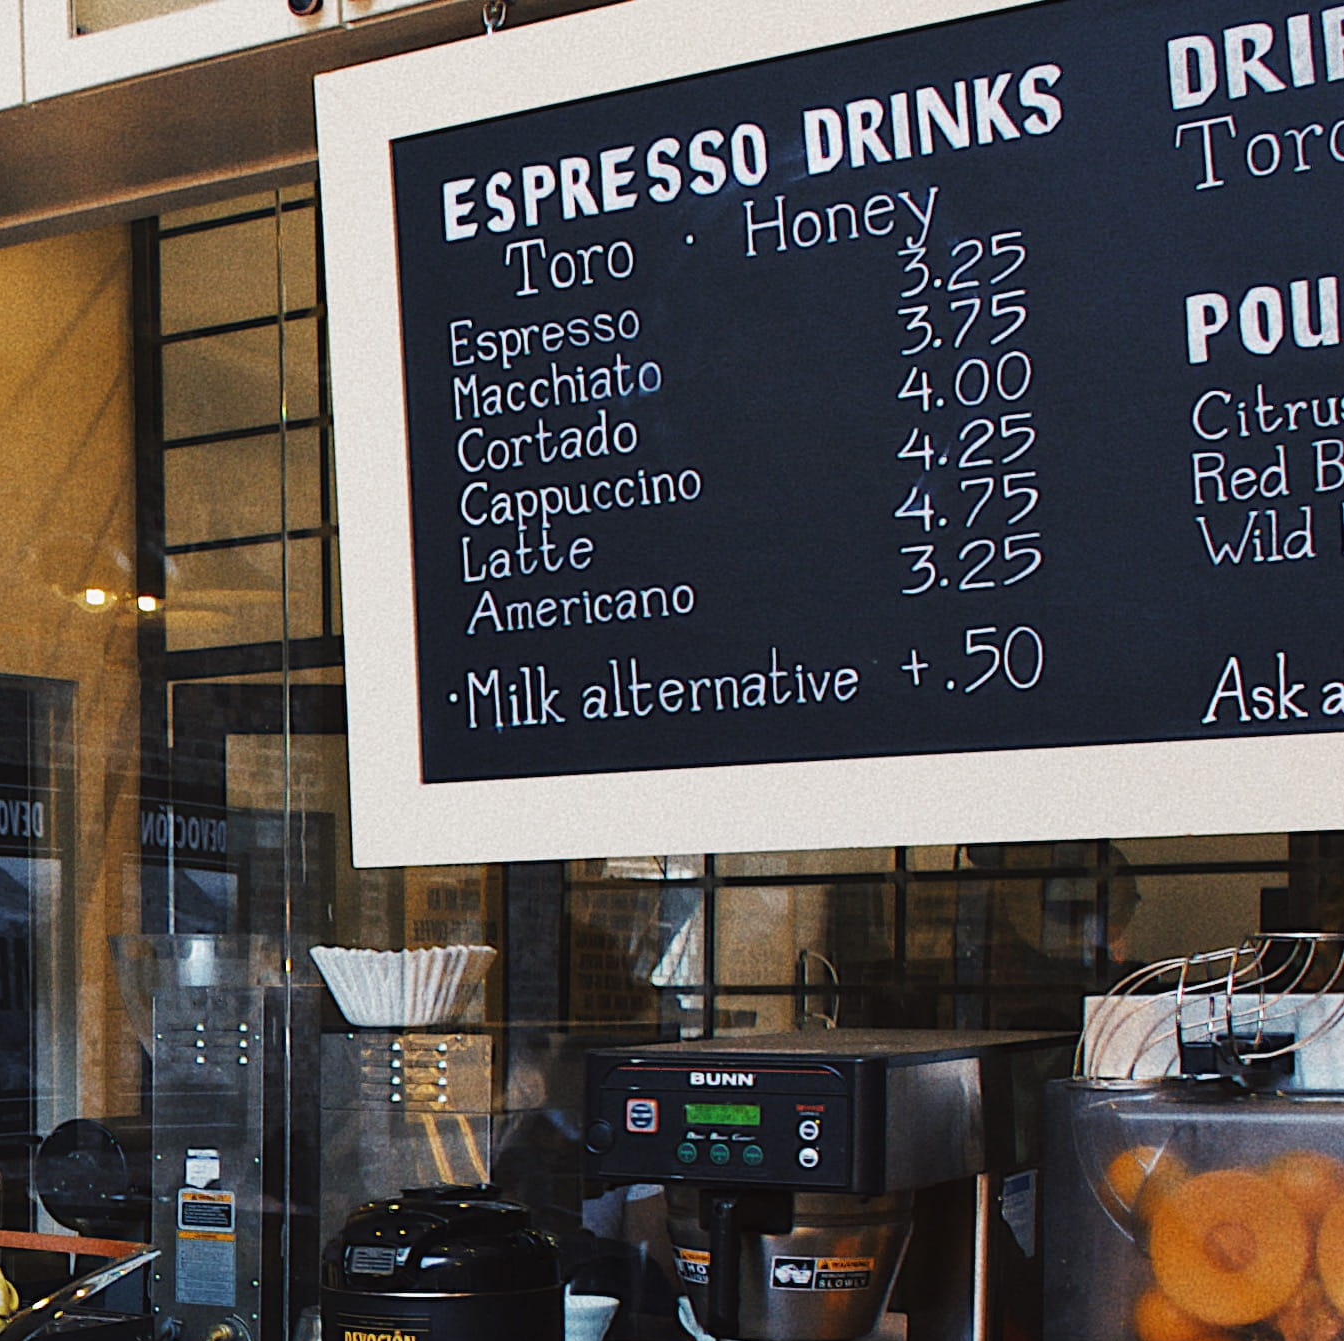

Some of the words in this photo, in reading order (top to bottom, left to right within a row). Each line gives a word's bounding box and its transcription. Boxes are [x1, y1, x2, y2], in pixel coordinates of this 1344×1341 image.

[443, 122, 768, 242] ESPRESSO
[803, 64, 1062, 175] DRINKS
[505, 238, 634, 297] Toro
[743, 186, 939, 257] Honey
[450, 309, 640, 369] Espresso
[897, 231, 1027, 298] 3.25
[1185, 275, 1341, 364] POU
[453, 353, 662, 421] Macchiato
[897, 289, 1028, 355] 3.75
[457, 409, 639, 473] Cortado
[897, 351, 1032, 411] 4.00
[1192, 384, 1344, 441] Citru
[461, 468, 702, 532] Cappuccino
[897, 411, 1036, 471] 4.25
[1192, 445, 1290, 504] Red
[462, 528, 594, 583] Latte
[894, 471, 1039, 532] 4.75
[1195, 506, 1317, 565] Wild
[466, 584, 695, 635] Americano
[901, 532, 1042, 595] 3.25
[467, 666, 565, 729] Milk
[582, 647, 859, 719] alternative
[1201, 651, 1308, 724] Ask
[690, 1072, 754, 1087] BUNN
